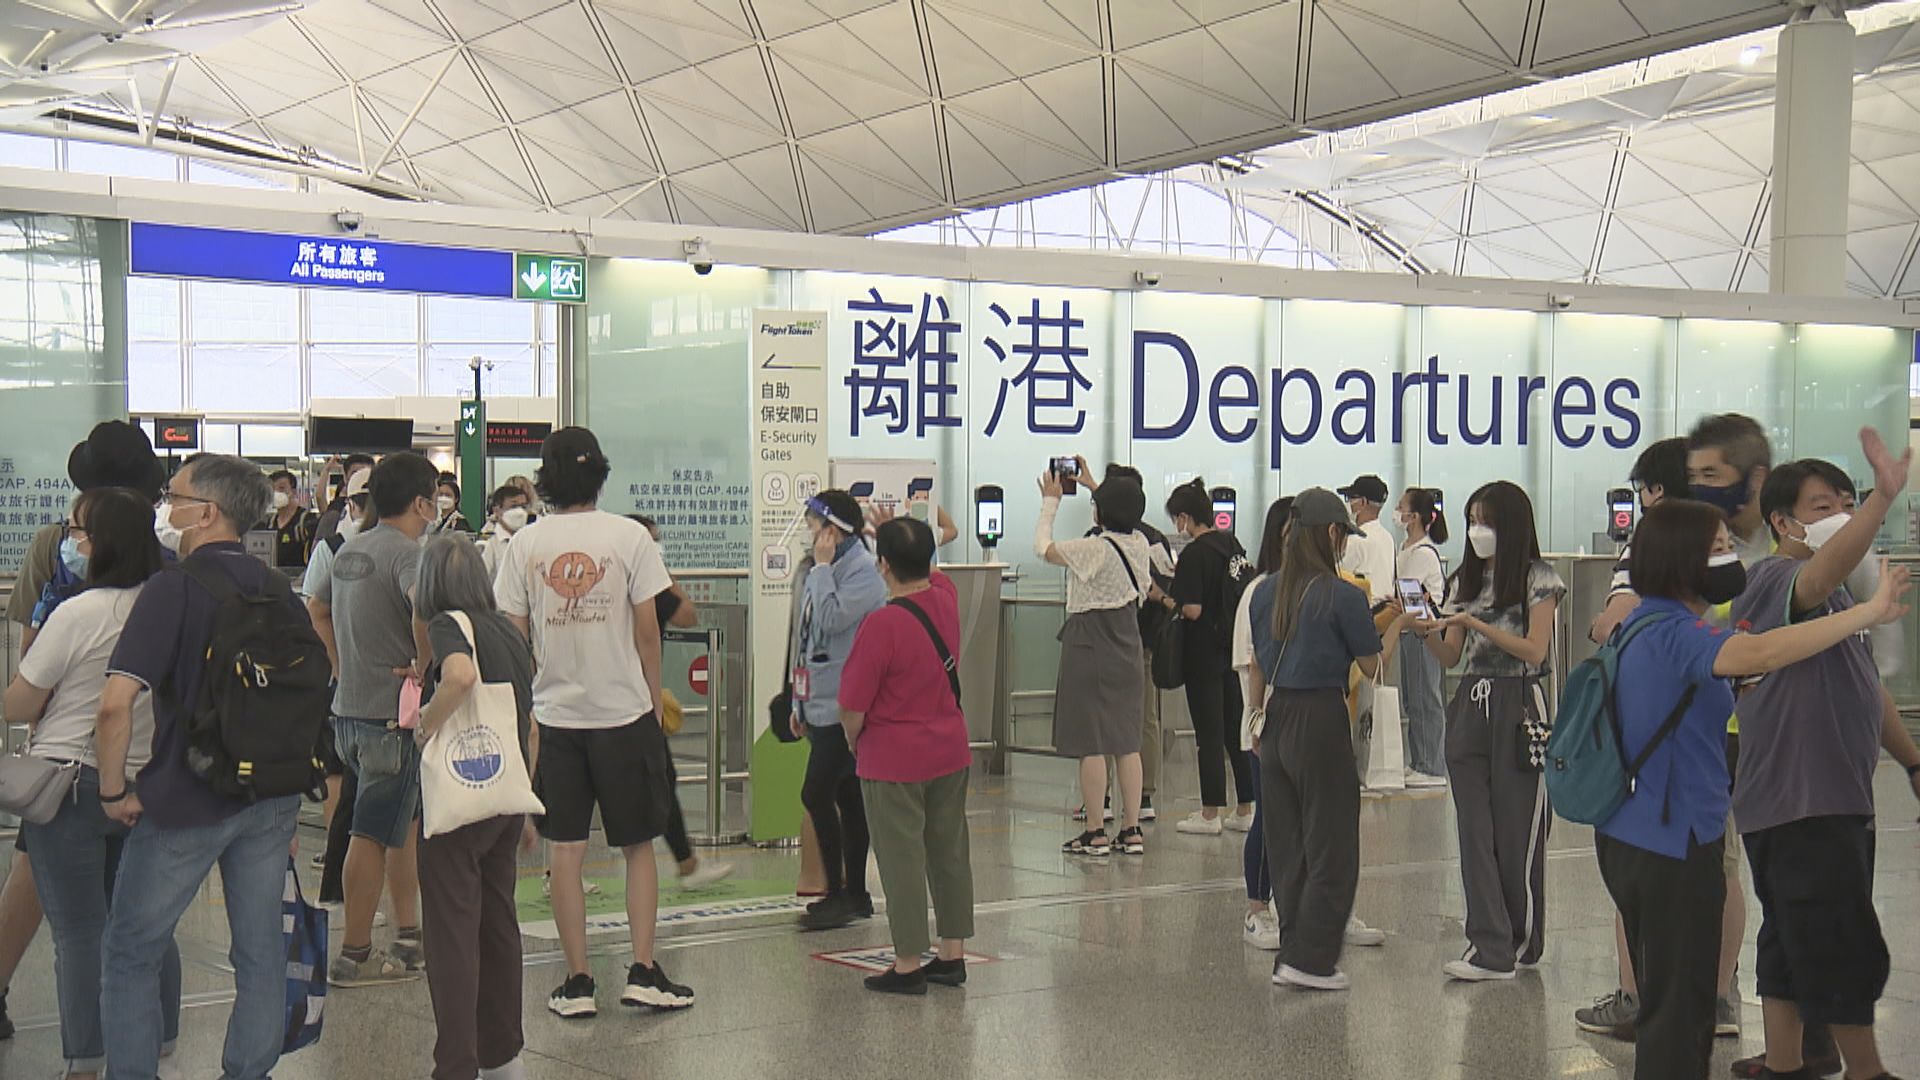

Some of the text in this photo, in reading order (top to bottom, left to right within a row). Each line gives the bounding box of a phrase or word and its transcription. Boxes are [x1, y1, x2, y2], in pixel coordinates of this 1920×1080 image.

[298, 242, 377, 267] 所有旅客
[290, 262, 384, 283] All Passengers
[844, 287, 1642, 469] 離港 Departures
[761, 382, 790, 399] 自助
[761, 406, 818, 423] 保安閘口
[760, 430, 817, 446] E-Security
[761, 448, 792, 461] Gates
[673, 469, 714, 481] 保安告示
[630, 483, 692, 496] 航空保安規例
[699, 531, 726, 540] NOTICE
[684, 542, 723, 551] Regulation
[694, 551, 710, 559] with
[712, 551, 729, 559] valid
[685, 560, 715, 568] allowed
